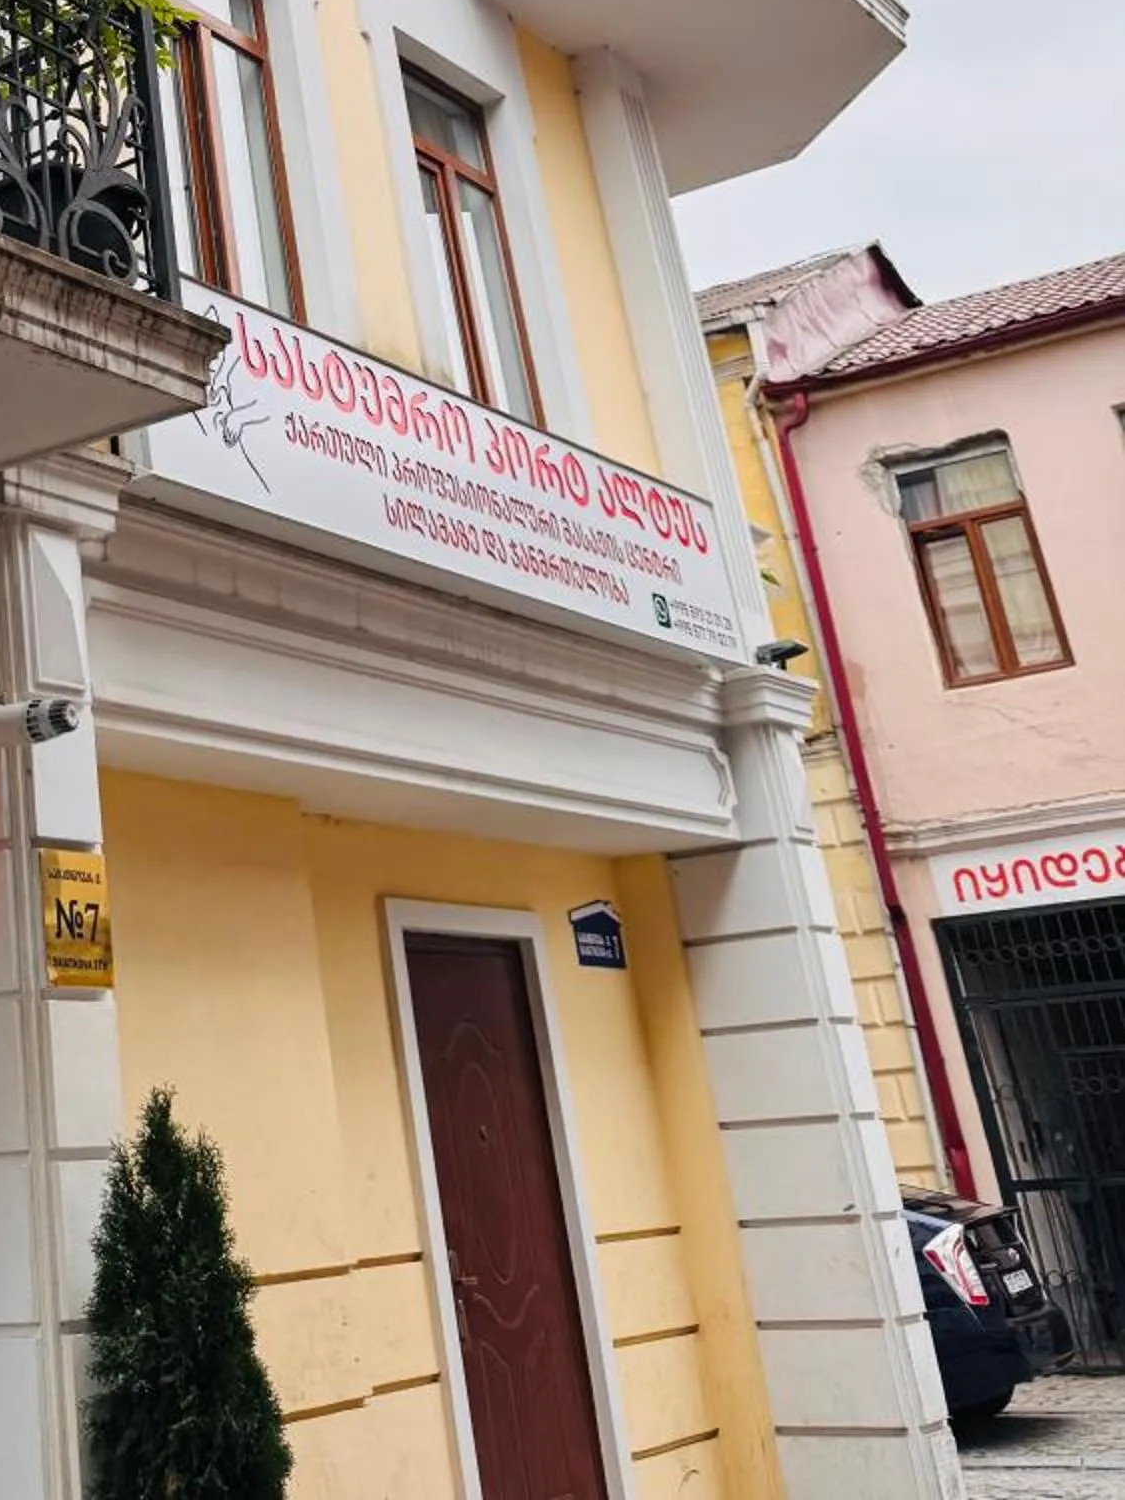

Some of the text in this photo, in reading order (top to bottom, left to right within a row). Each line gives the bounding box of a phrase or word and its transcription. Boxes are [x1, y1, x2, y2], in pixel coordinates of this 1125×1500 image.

[236, 312, 709, 555] სასტუმრო პორტ ალტუს
[285, 411, 388, 480] ქართული
[482, 529, 508, 564] და
